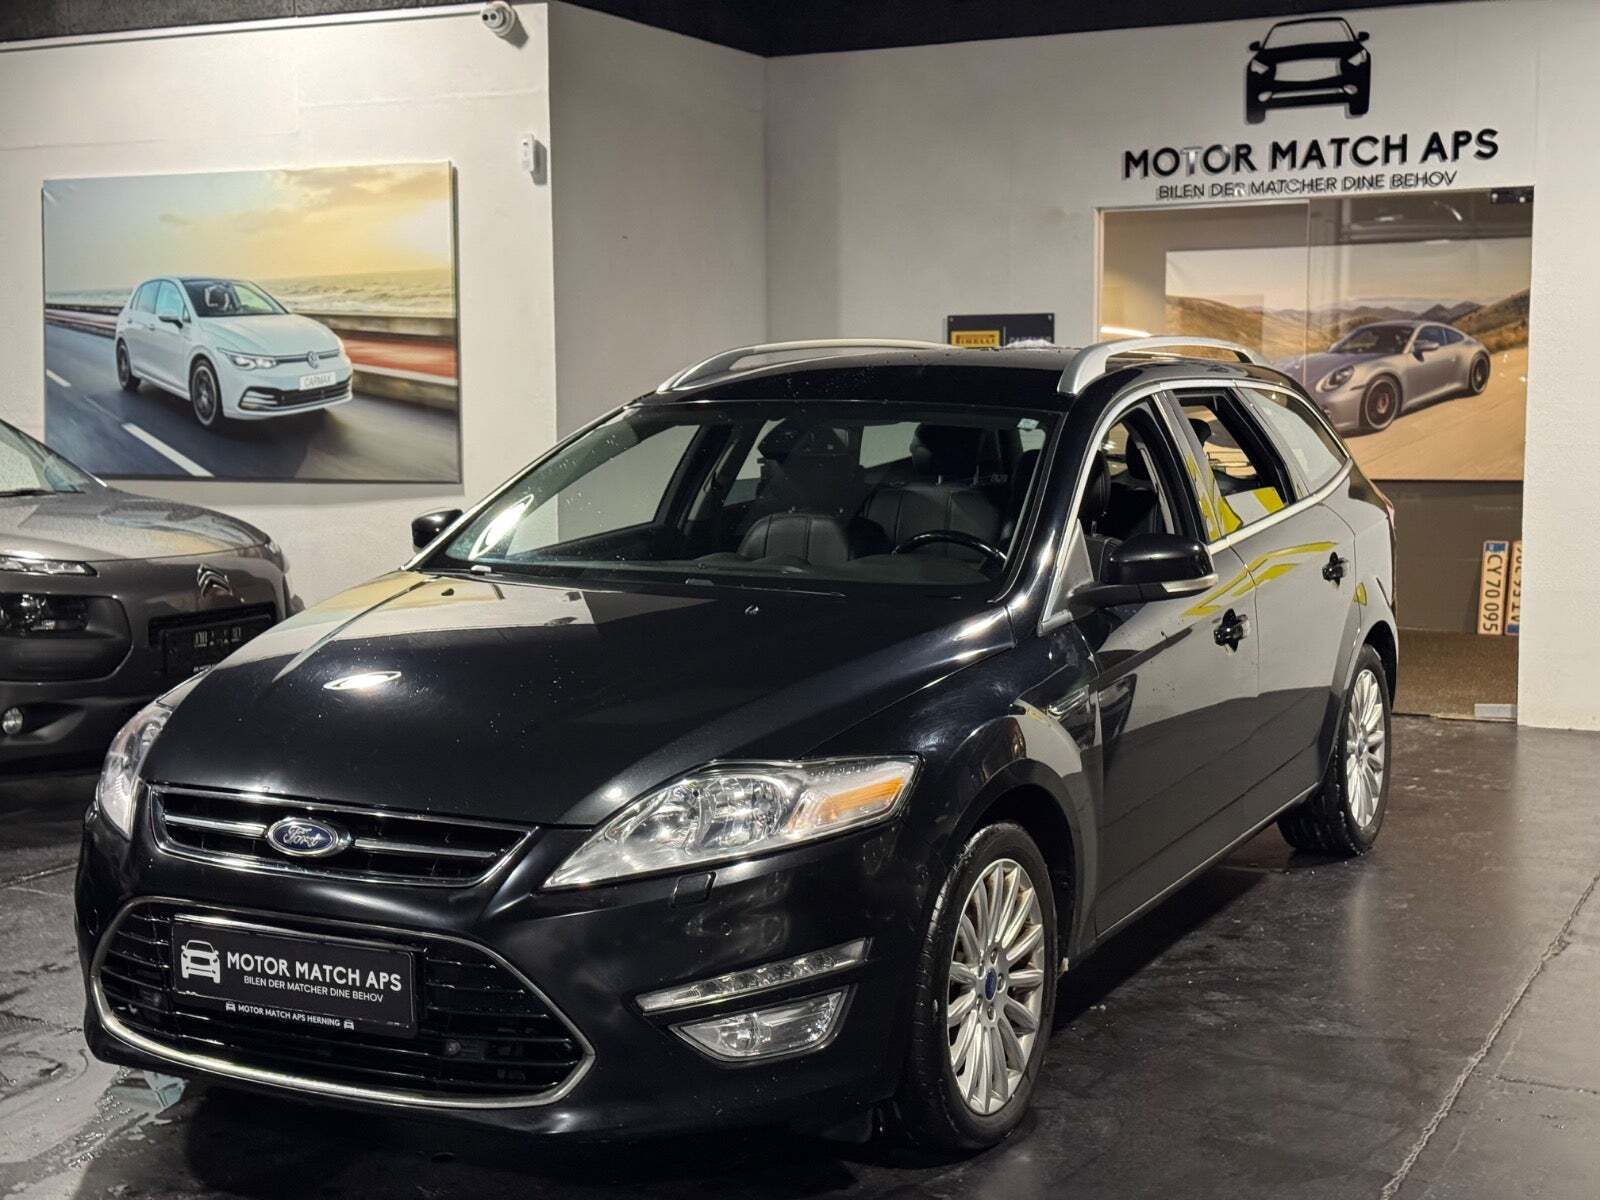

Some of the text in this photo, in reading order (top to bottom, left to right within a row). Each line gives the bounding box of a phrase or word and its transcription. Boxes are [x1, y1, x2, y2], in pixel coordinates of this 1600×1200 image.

[1124, 128, 1499, 178] MOTOR MATCH APS
[1158, 170, 1458, 199] BILEN DER MATCHER DINE BEHOV
[283, 825, 323, 848] Ford
[226, 951, 402, 992] MOTOR MATCH APS
[243, 975, 384, 1003] BILEN DER MATCHER DINE BEHOV
[238, 1004, 341, 1027] MOTOR MATCH APS HERNING
